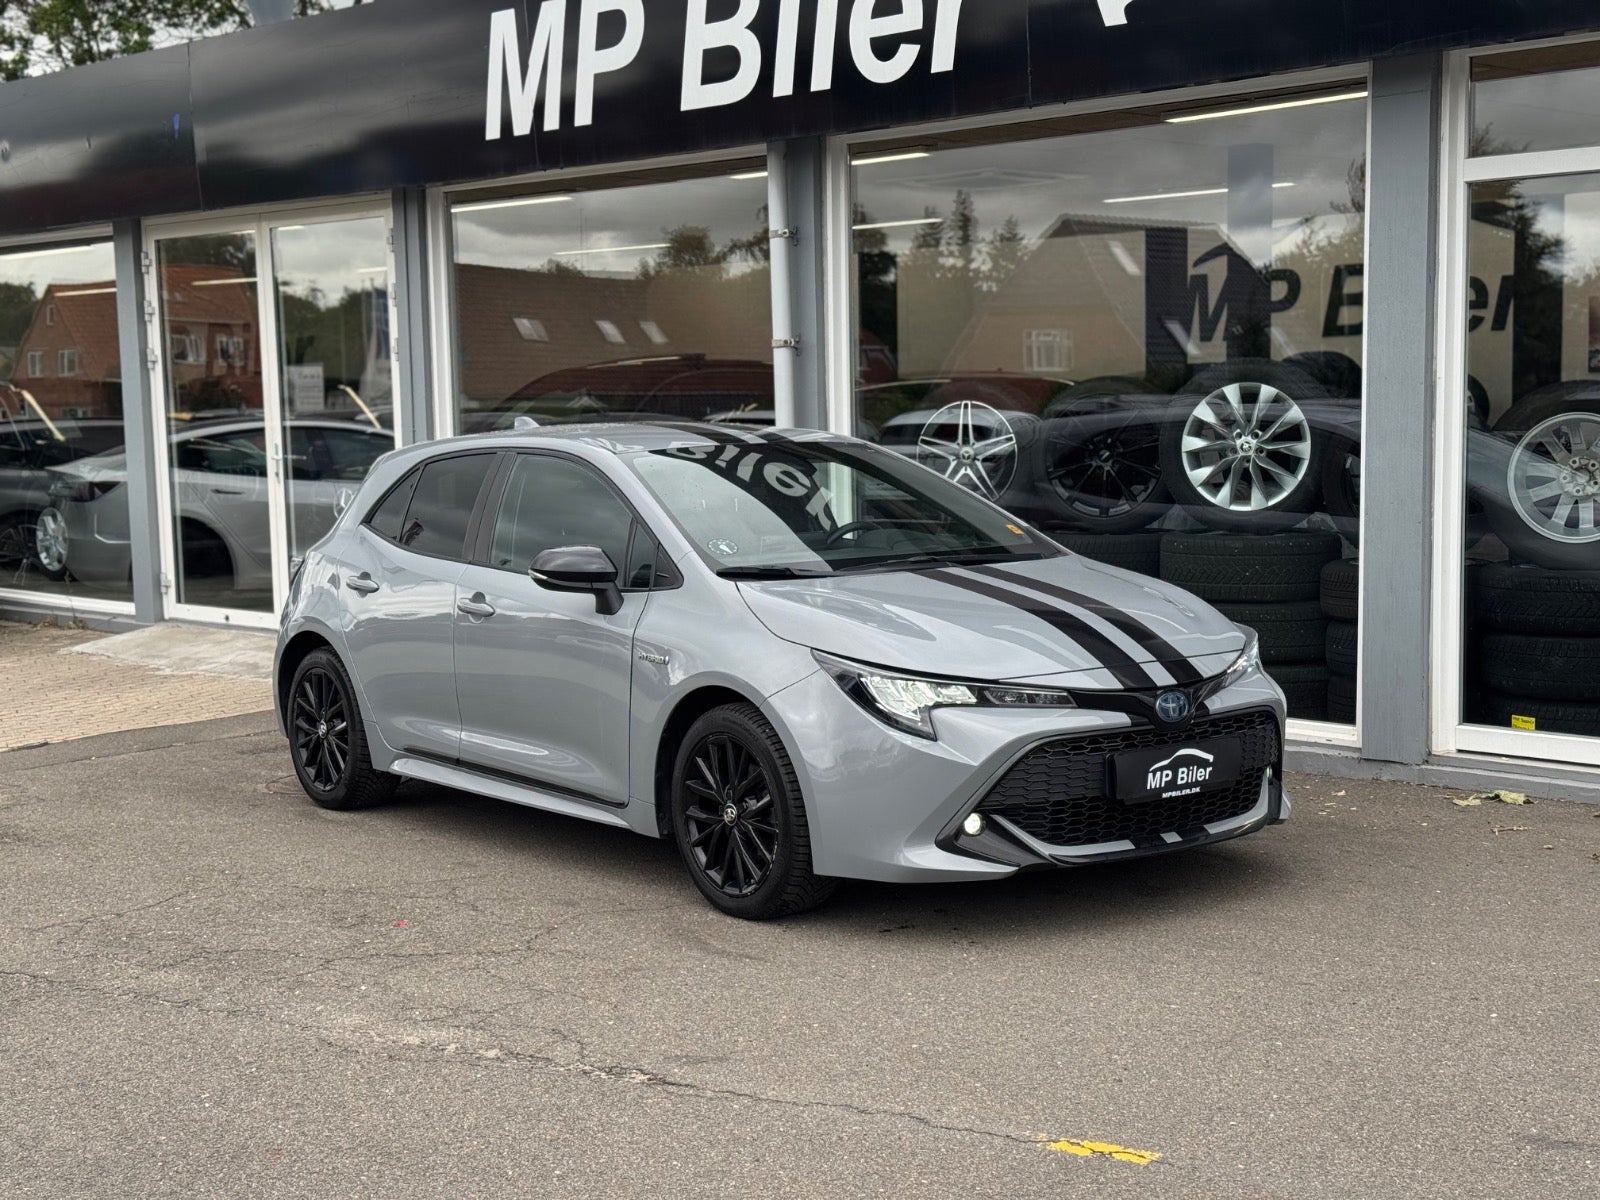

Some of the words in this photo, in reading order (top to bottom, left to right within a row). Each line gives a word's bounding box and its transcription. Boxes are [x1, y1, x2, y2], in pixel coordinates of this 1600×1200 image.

[485, 0, 645, 140] MP
[1146, 769, 1173, 790] MP
[1176, 765, 1213, 785] Biler
